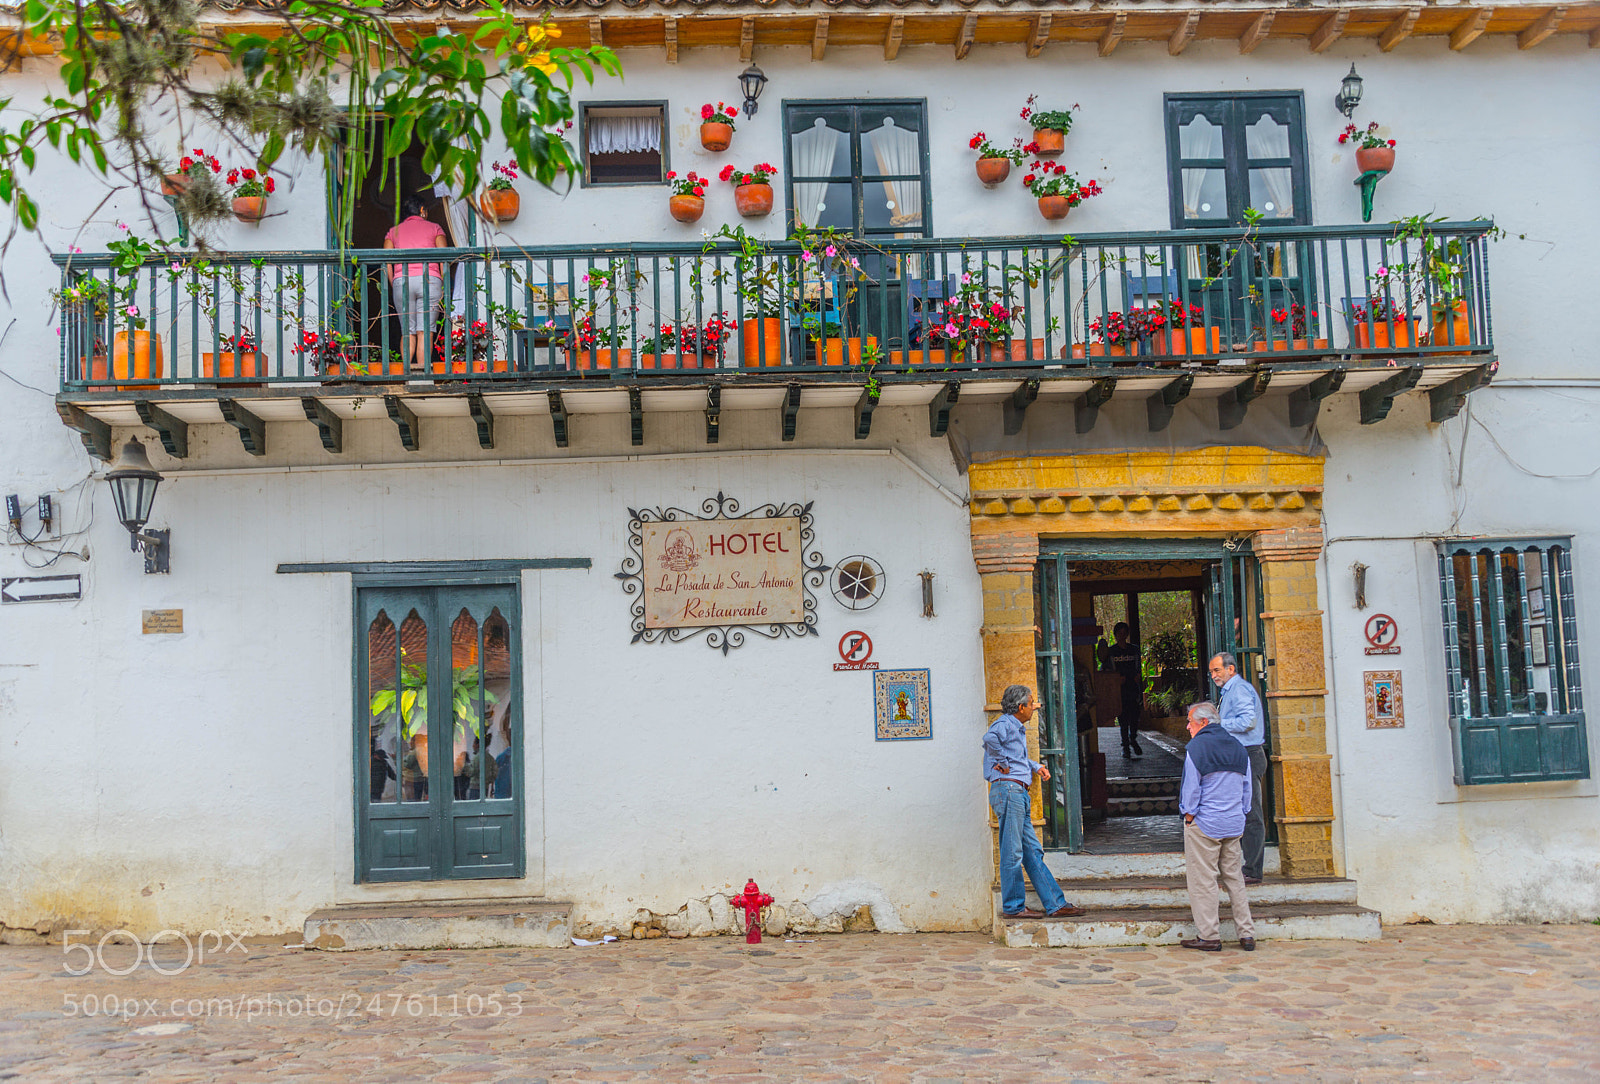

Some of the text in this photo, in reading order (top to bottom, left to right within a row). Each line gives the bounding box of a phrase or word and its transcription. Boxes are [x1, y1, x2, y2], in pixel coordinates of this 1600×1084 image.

[709, 531, 789, 556] HOTEL
[654, 570, 794, 594] La Posada de San Antonio
[684, 597, 768, 619] Restaurante
